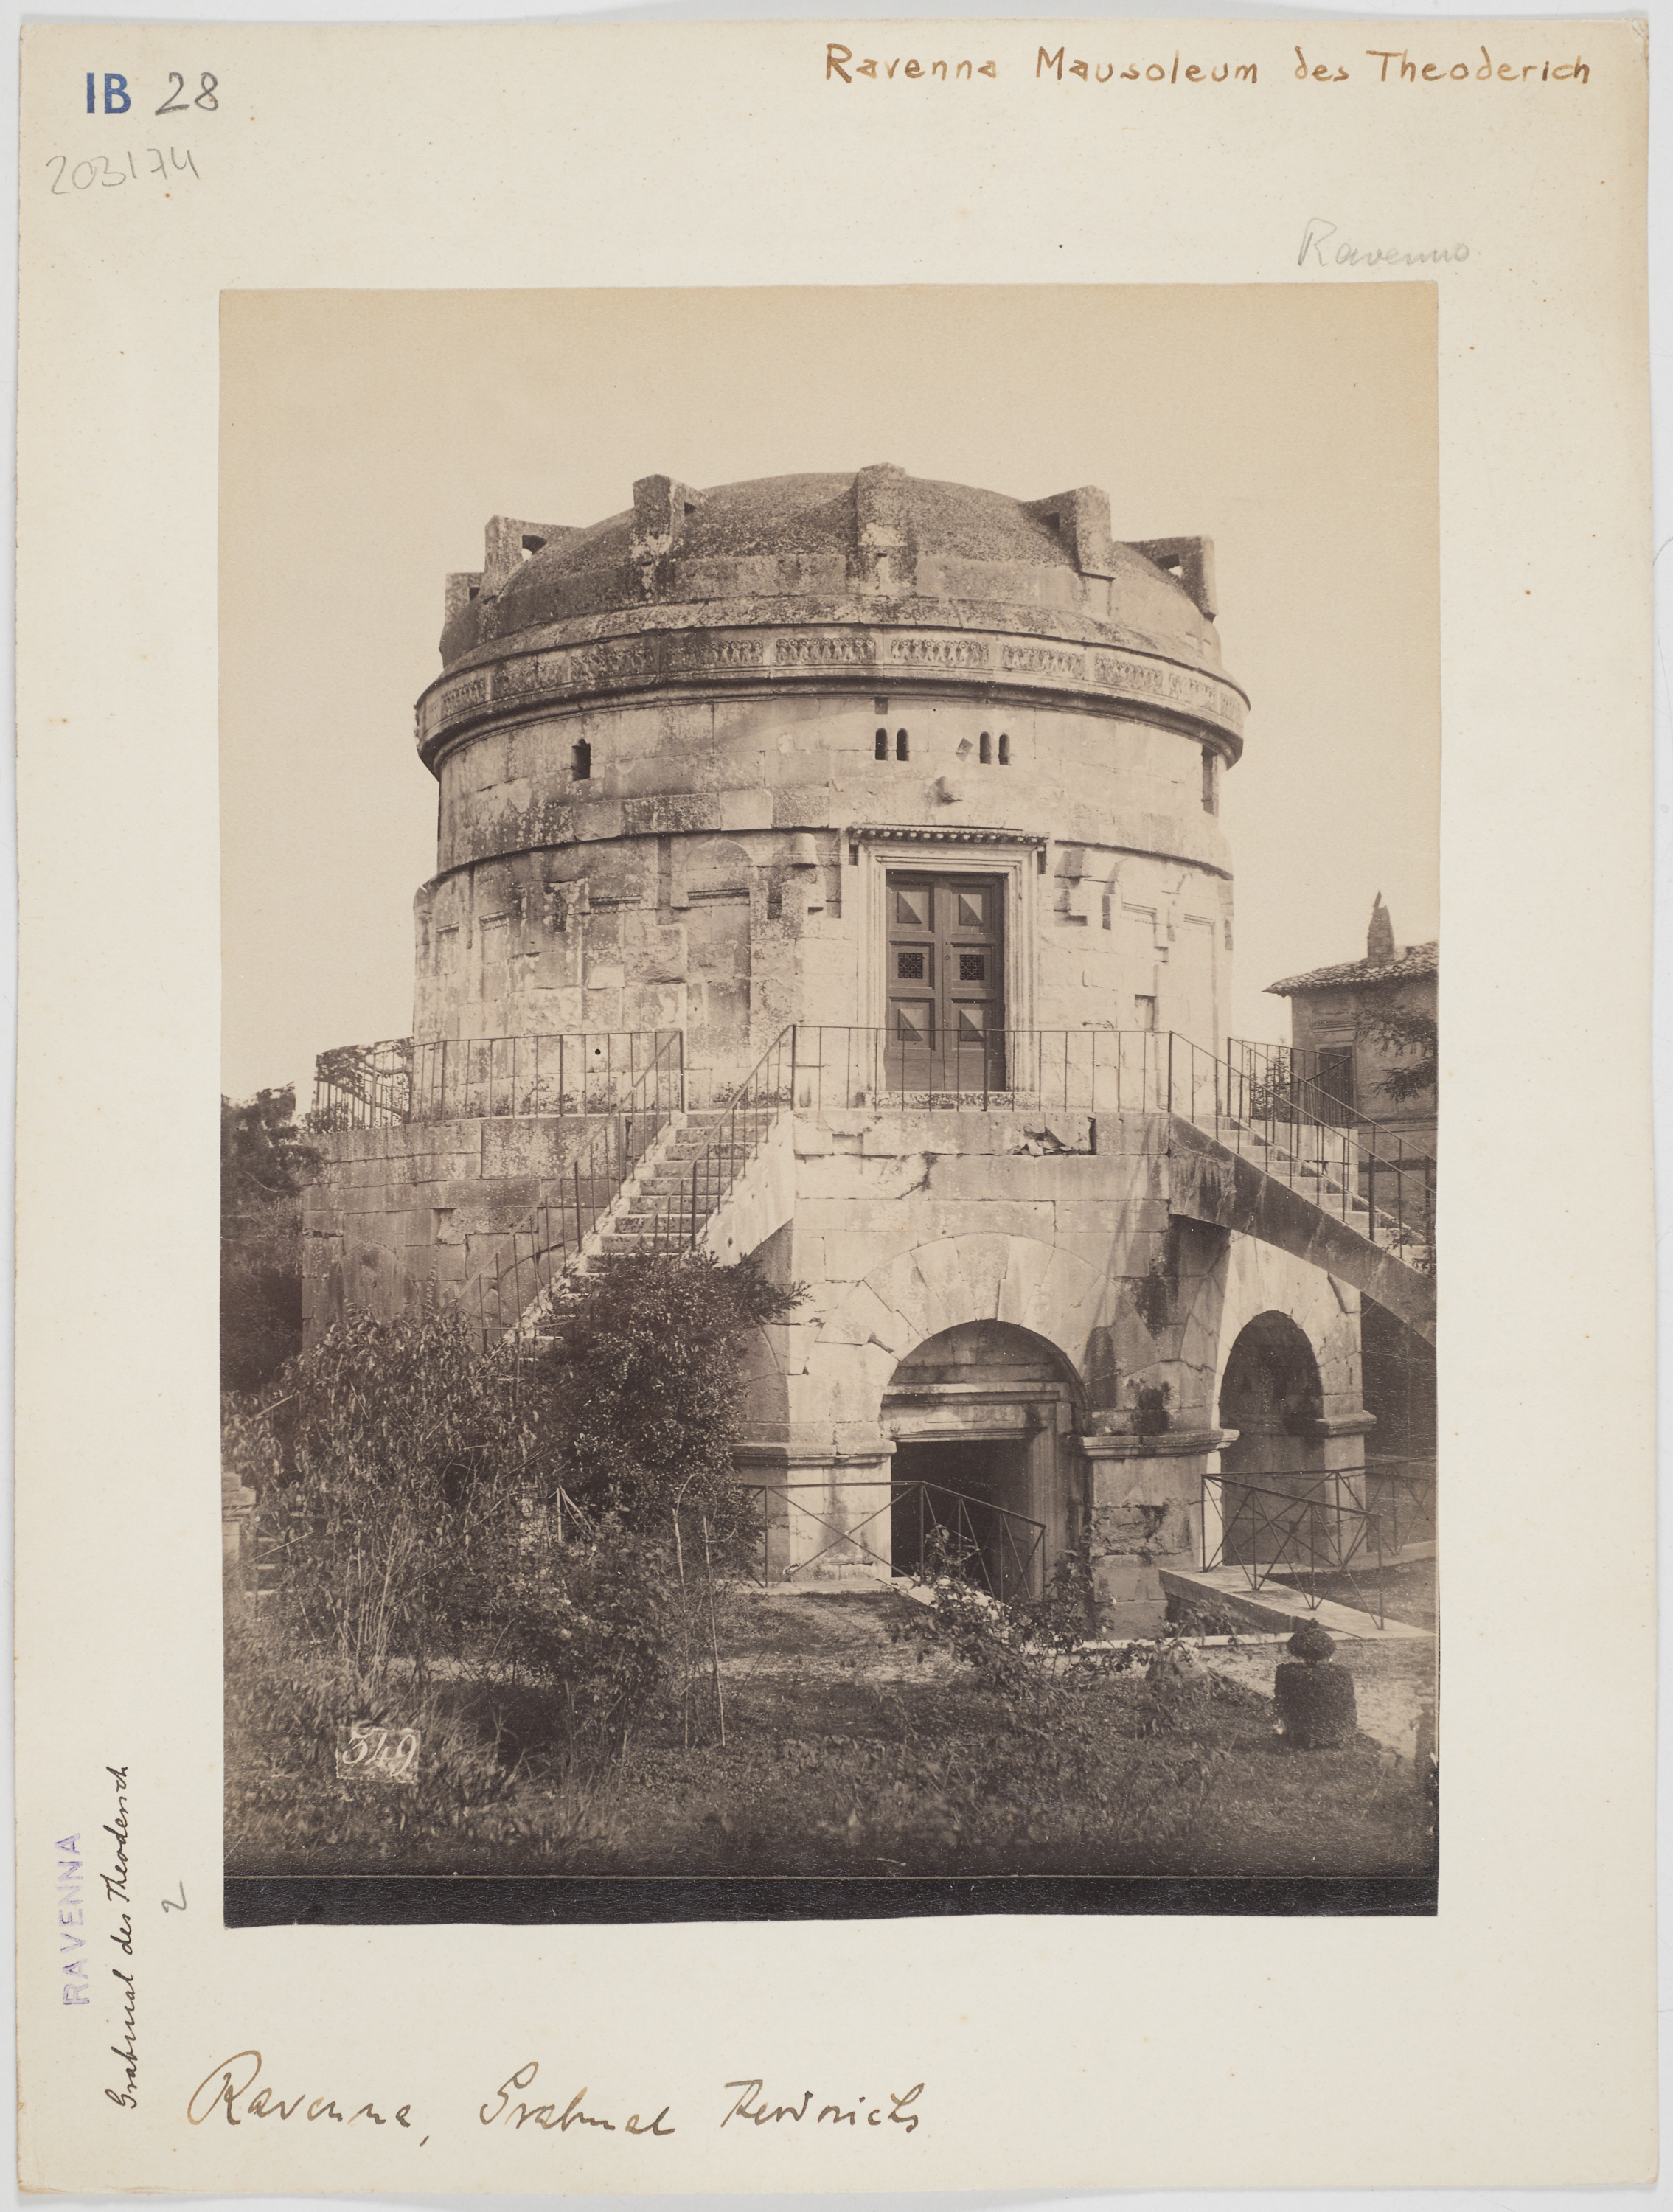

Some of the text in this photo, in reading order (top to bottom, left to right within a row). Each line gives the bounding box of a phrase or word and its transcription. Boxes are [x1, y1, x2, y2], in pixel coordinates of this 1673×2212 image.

[825, 42, 1590, 86] Ravenna Mausoleum des Theoderich
[154, 71, 220, 117] 28
[45, 146, 201, 195] 203174
[55, 1832, 91, 2006] RAVENNA
[161, 1879, 188, 1914] 2
[99, 1765, 139, 2110] Grabmal des Theoderich
[187, 2049, 430, 2148] Ravenna,
[479, 2060, 676, 2137] Grabmal
